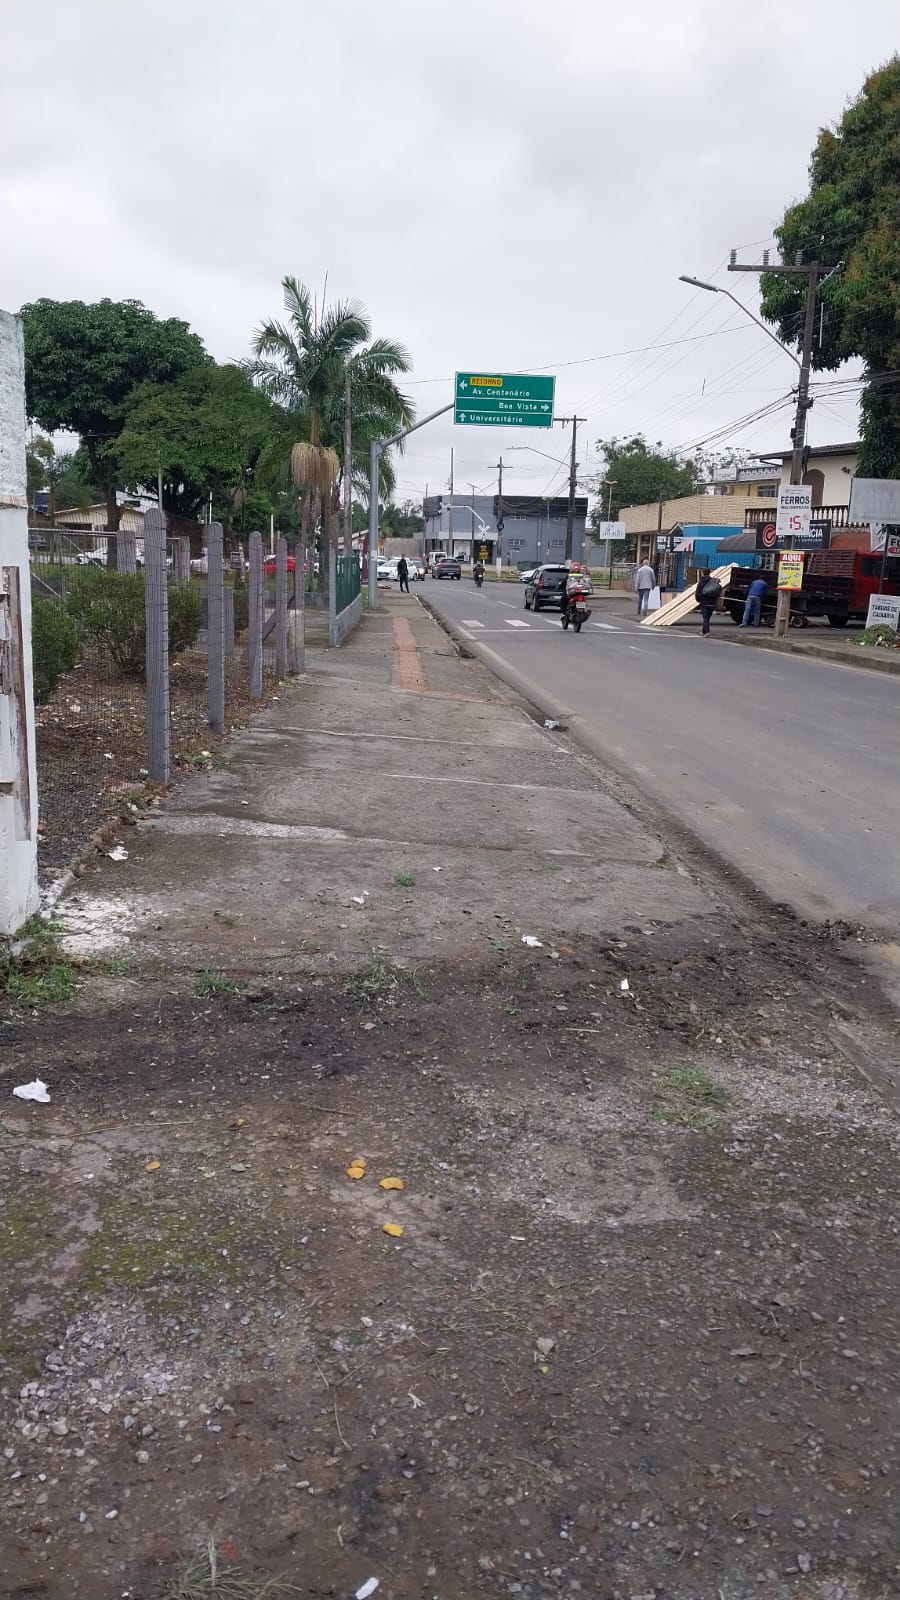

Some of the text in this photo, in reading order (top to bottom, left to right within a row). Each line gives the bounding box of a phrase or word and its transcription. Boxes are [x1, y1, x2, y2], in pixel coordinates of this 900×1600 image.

[486, 388, 530, 397] Centenário
[470, 414, 523, 423] Universitário
[781, 496, 810, 505] FERROS
